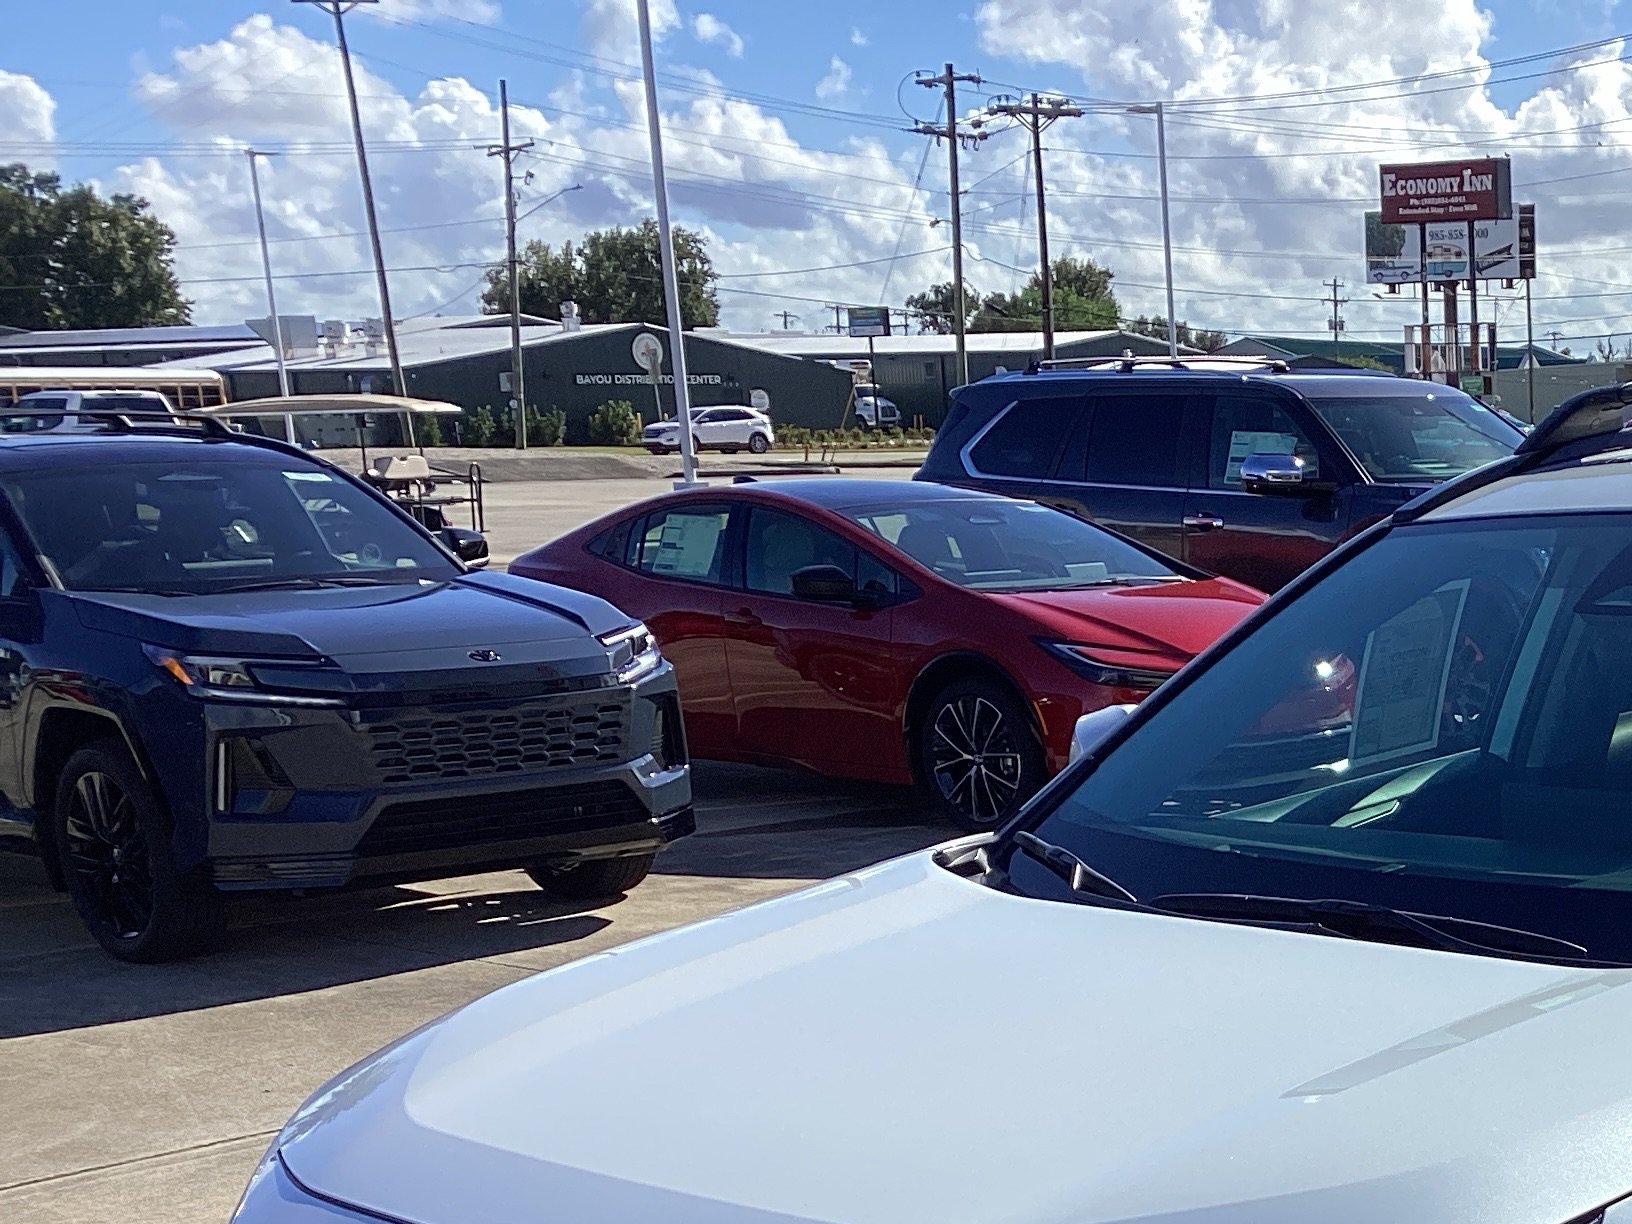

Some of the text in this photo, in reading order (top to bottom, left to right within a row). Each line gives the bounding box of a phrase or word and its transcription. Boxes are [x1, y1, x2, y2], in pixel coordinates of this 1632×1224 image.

[1383, 169, 1493, 196] ECONOMY INN
[576, 374, 612, 385] BAYOU
[686, 374, 721, 385] CENTER
